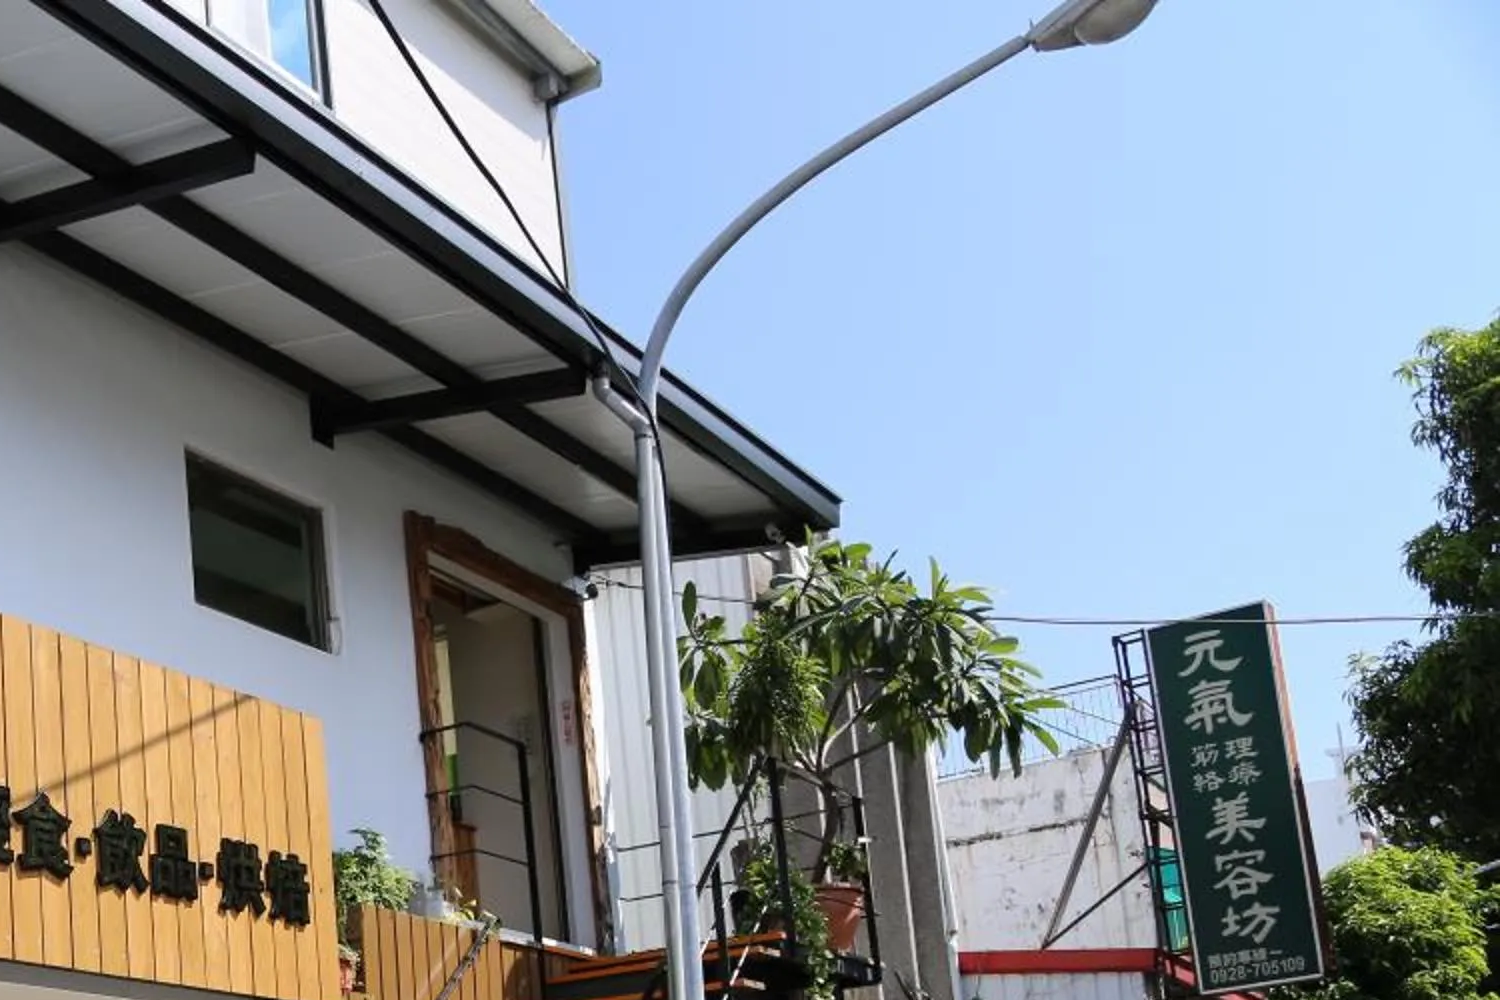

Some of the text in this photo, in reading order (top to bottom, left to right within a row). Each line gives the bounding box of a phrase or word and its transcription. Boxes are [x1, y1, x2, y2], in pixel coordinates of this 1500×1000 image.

[1177, 629, 1255, 735] 元氣
[1205, 791, 1280, 944] 美容坊
